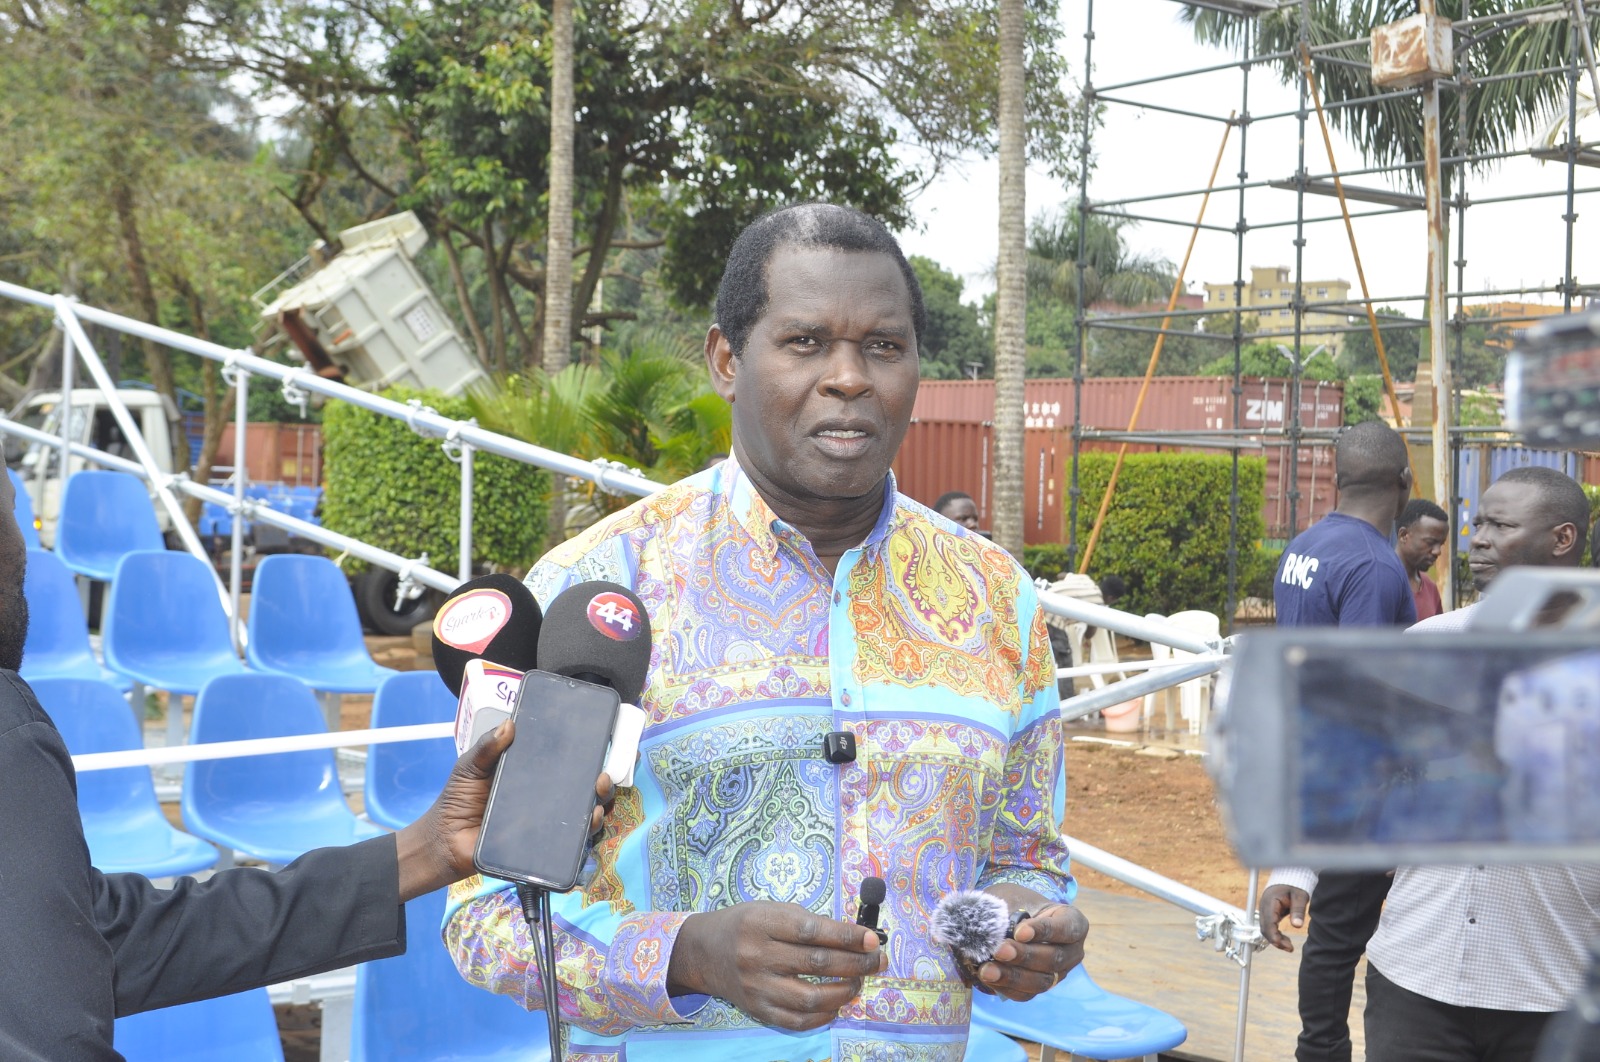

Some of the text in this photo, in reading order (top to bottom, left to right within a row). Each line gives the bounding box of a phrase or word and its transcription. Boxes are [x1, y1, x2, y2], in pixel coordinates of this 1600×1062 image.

[1246, 399, 1283, 421] ZIM
[1281, 553, 1319, 590] RMC
[595, 601, 634, 631] 44
